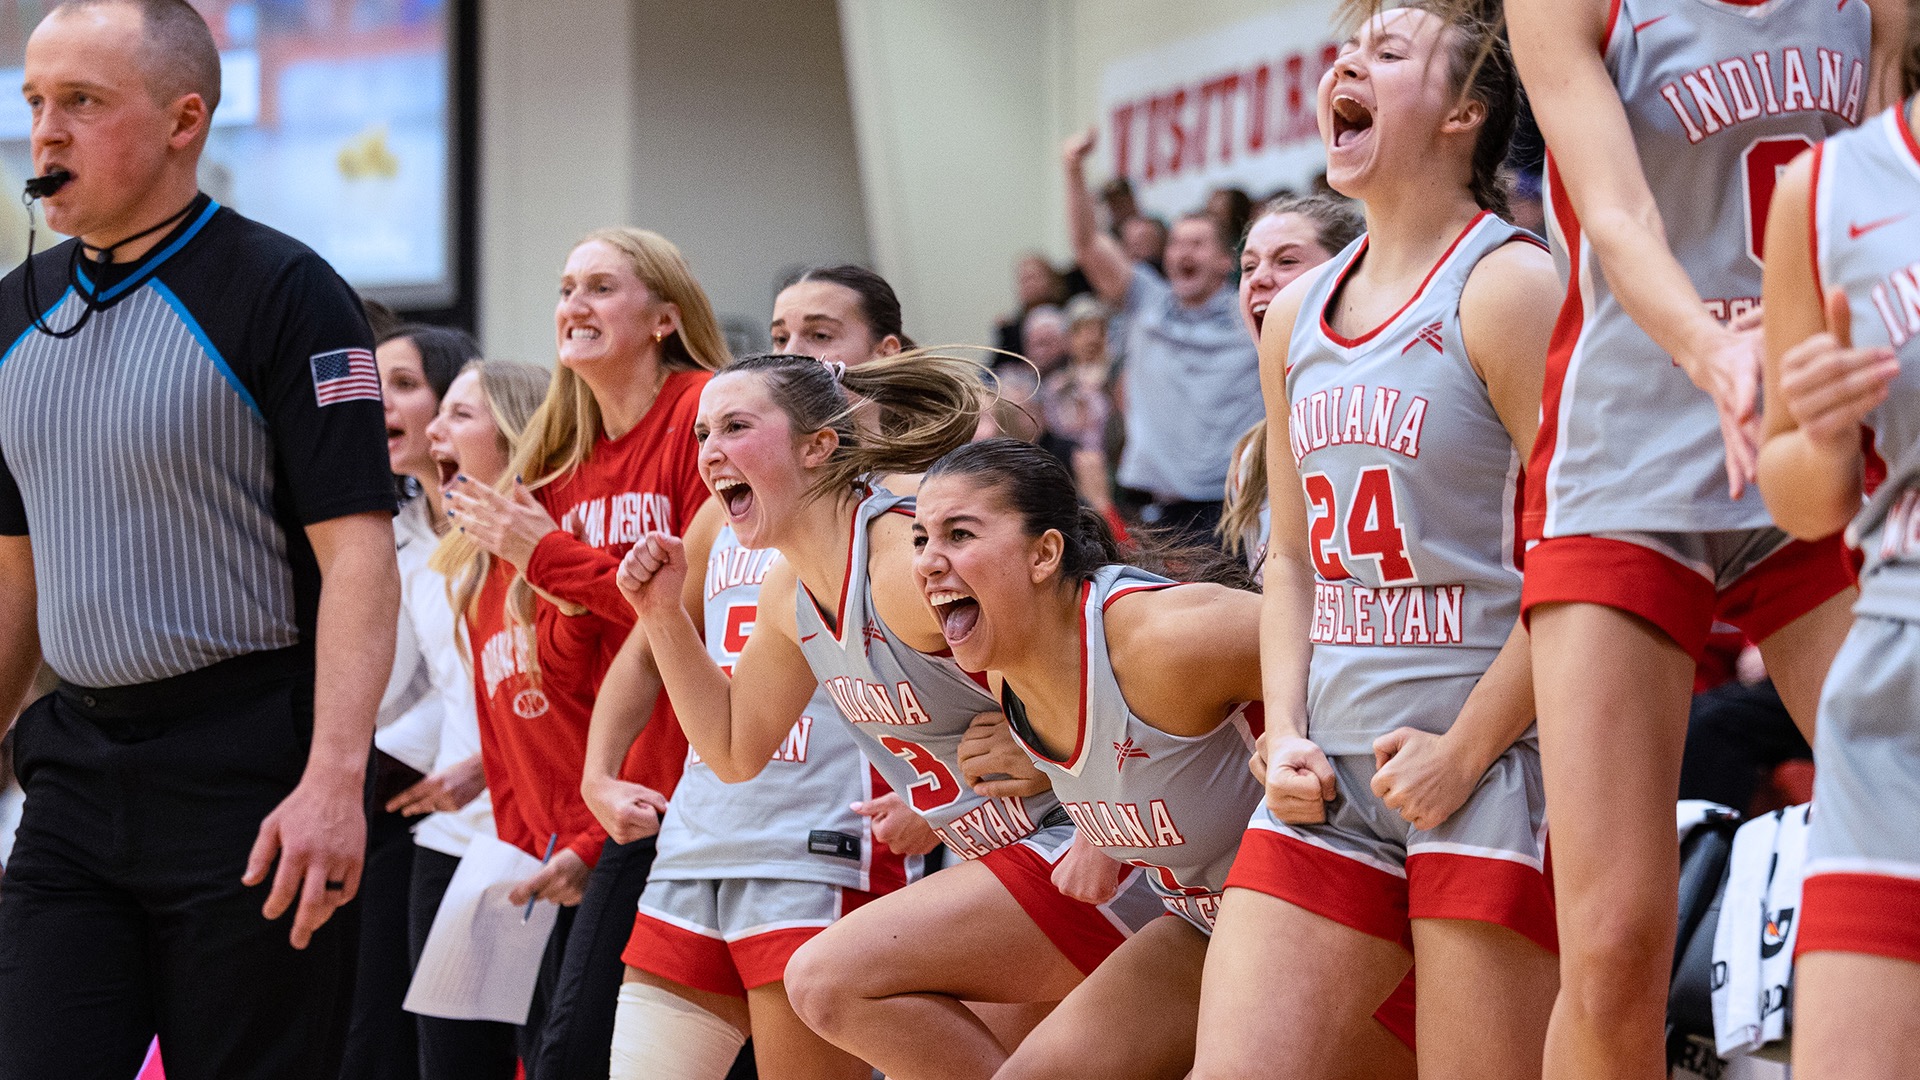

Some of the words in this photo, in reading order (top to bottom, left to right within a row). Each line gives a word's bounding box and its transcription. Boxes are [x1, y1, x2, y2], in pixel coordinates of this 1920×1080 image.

[1111, 43, 1338, 183] VISITOR
[1661, 47, 1863, 145] INDIANA
[1302, 464, 1419, 587] 24
[1309, 582, 1465, 645] ESLEYAN
[877, 734, 964, 816] 3
[933, 796, 1038, 861] LEYAN
[1060, 799, 1186, 848] DIANA
